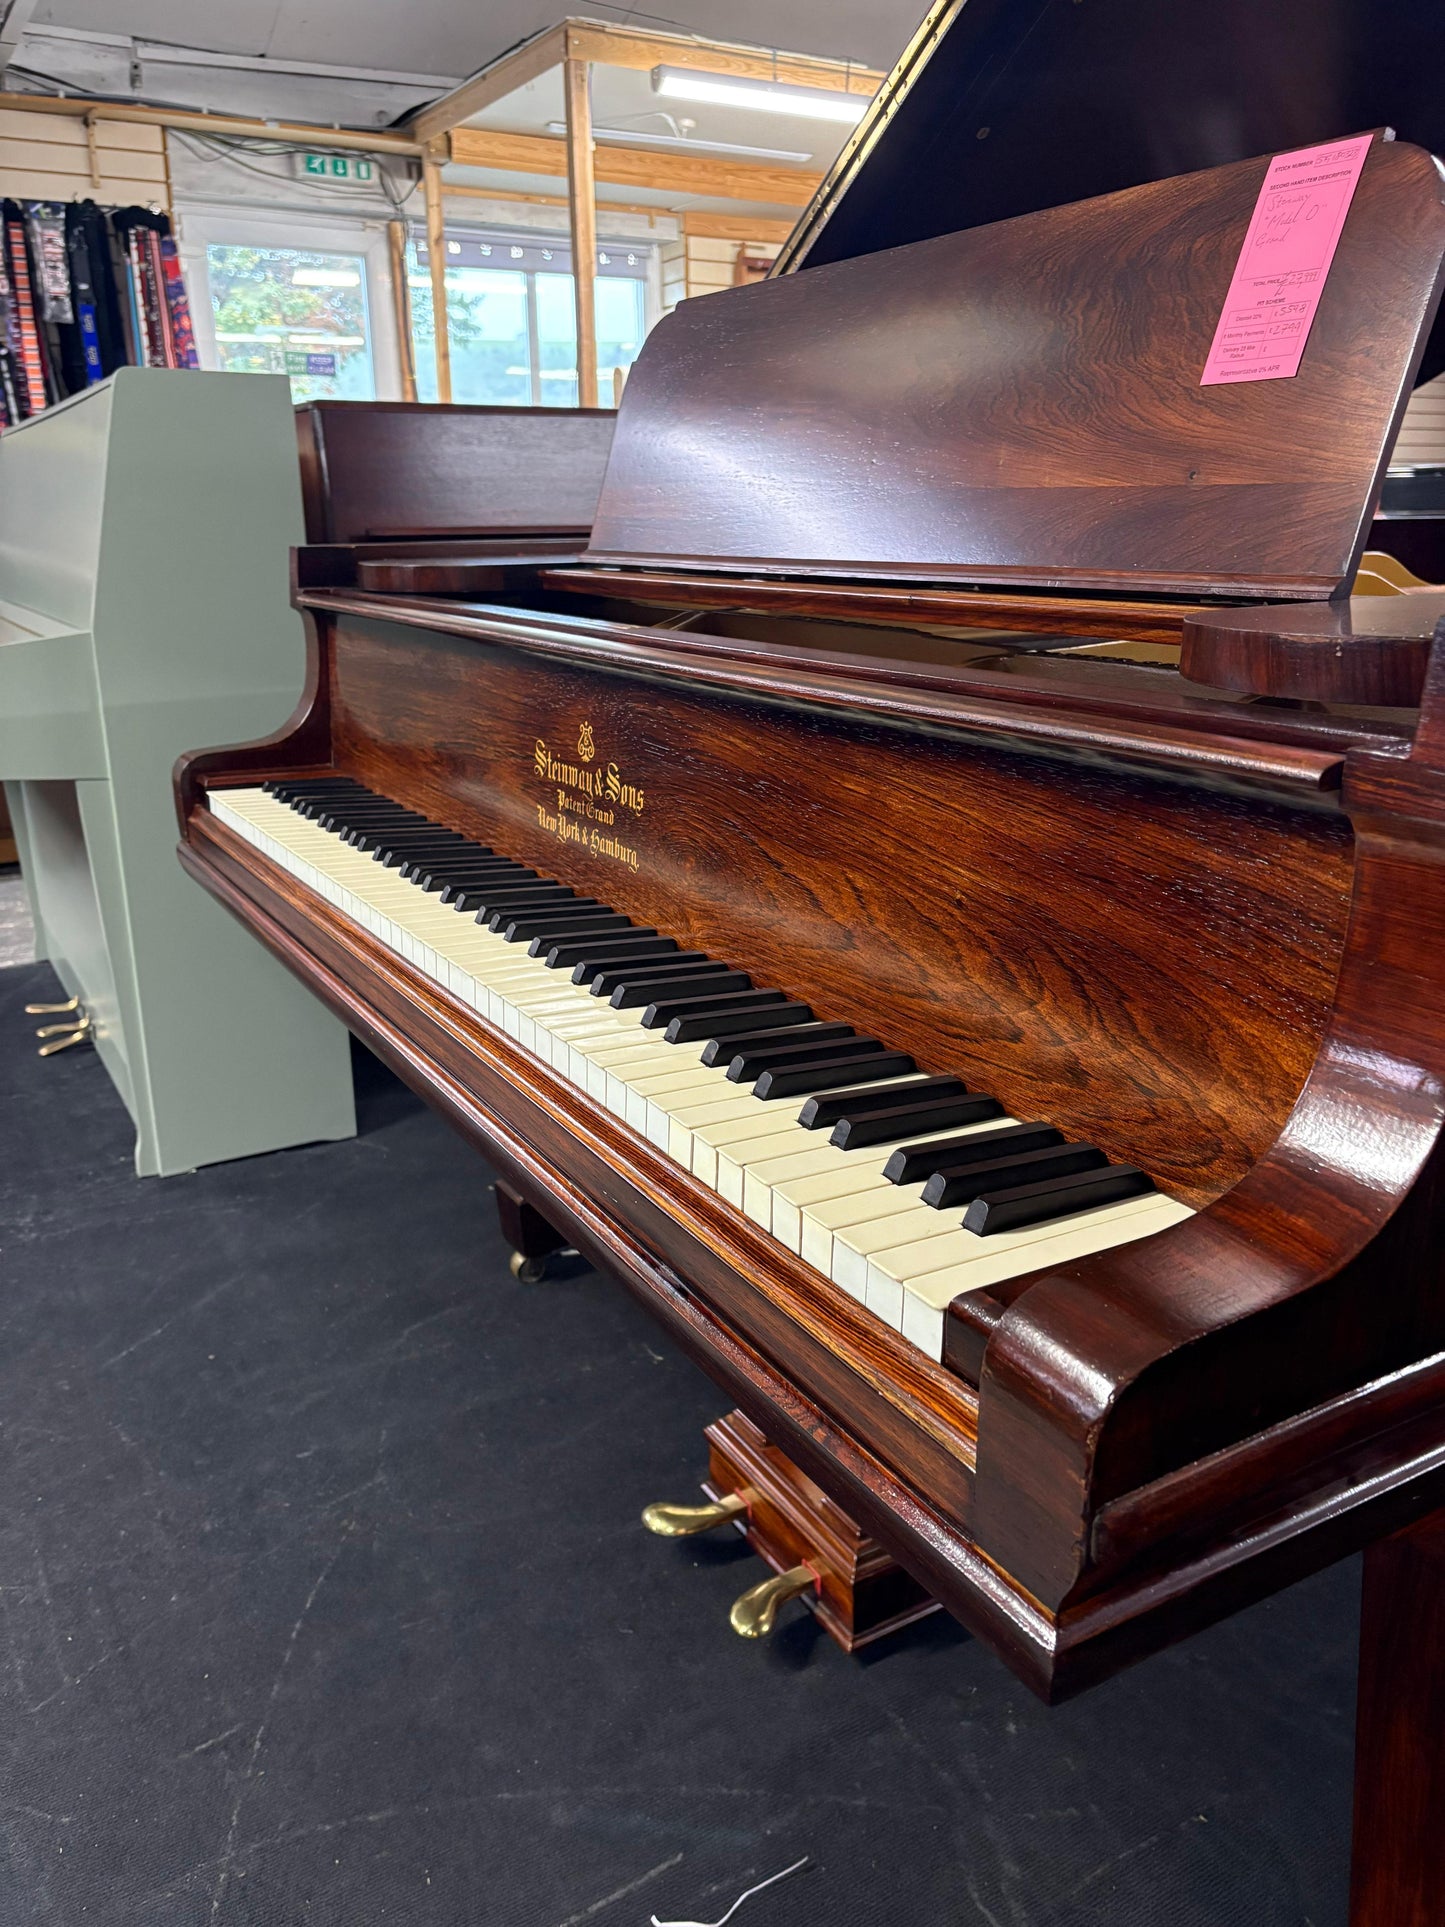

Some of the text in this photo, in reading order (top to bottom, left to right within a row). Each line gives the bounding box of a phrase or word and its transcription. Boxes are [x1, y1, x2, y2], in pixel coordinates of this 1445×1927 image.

[1274, 160, 1314, 173] STOCK NUMBER
[1269, 169, 1353, 191] SECOND HAND ITEM DESCRIPTION
[1265, 297, 1286, 305] SCHEME
[1219, 368, 1257, 377] Representative
[1267, 364, 1280, 372] APR
[534, 739, 645, 817] Steinway & Sons
[556, 789, 615, 826] Patent Grand
[536, 804, 557, 833] New
[557, 813, 580, 844] York
[581, 826, 588, 846] &
